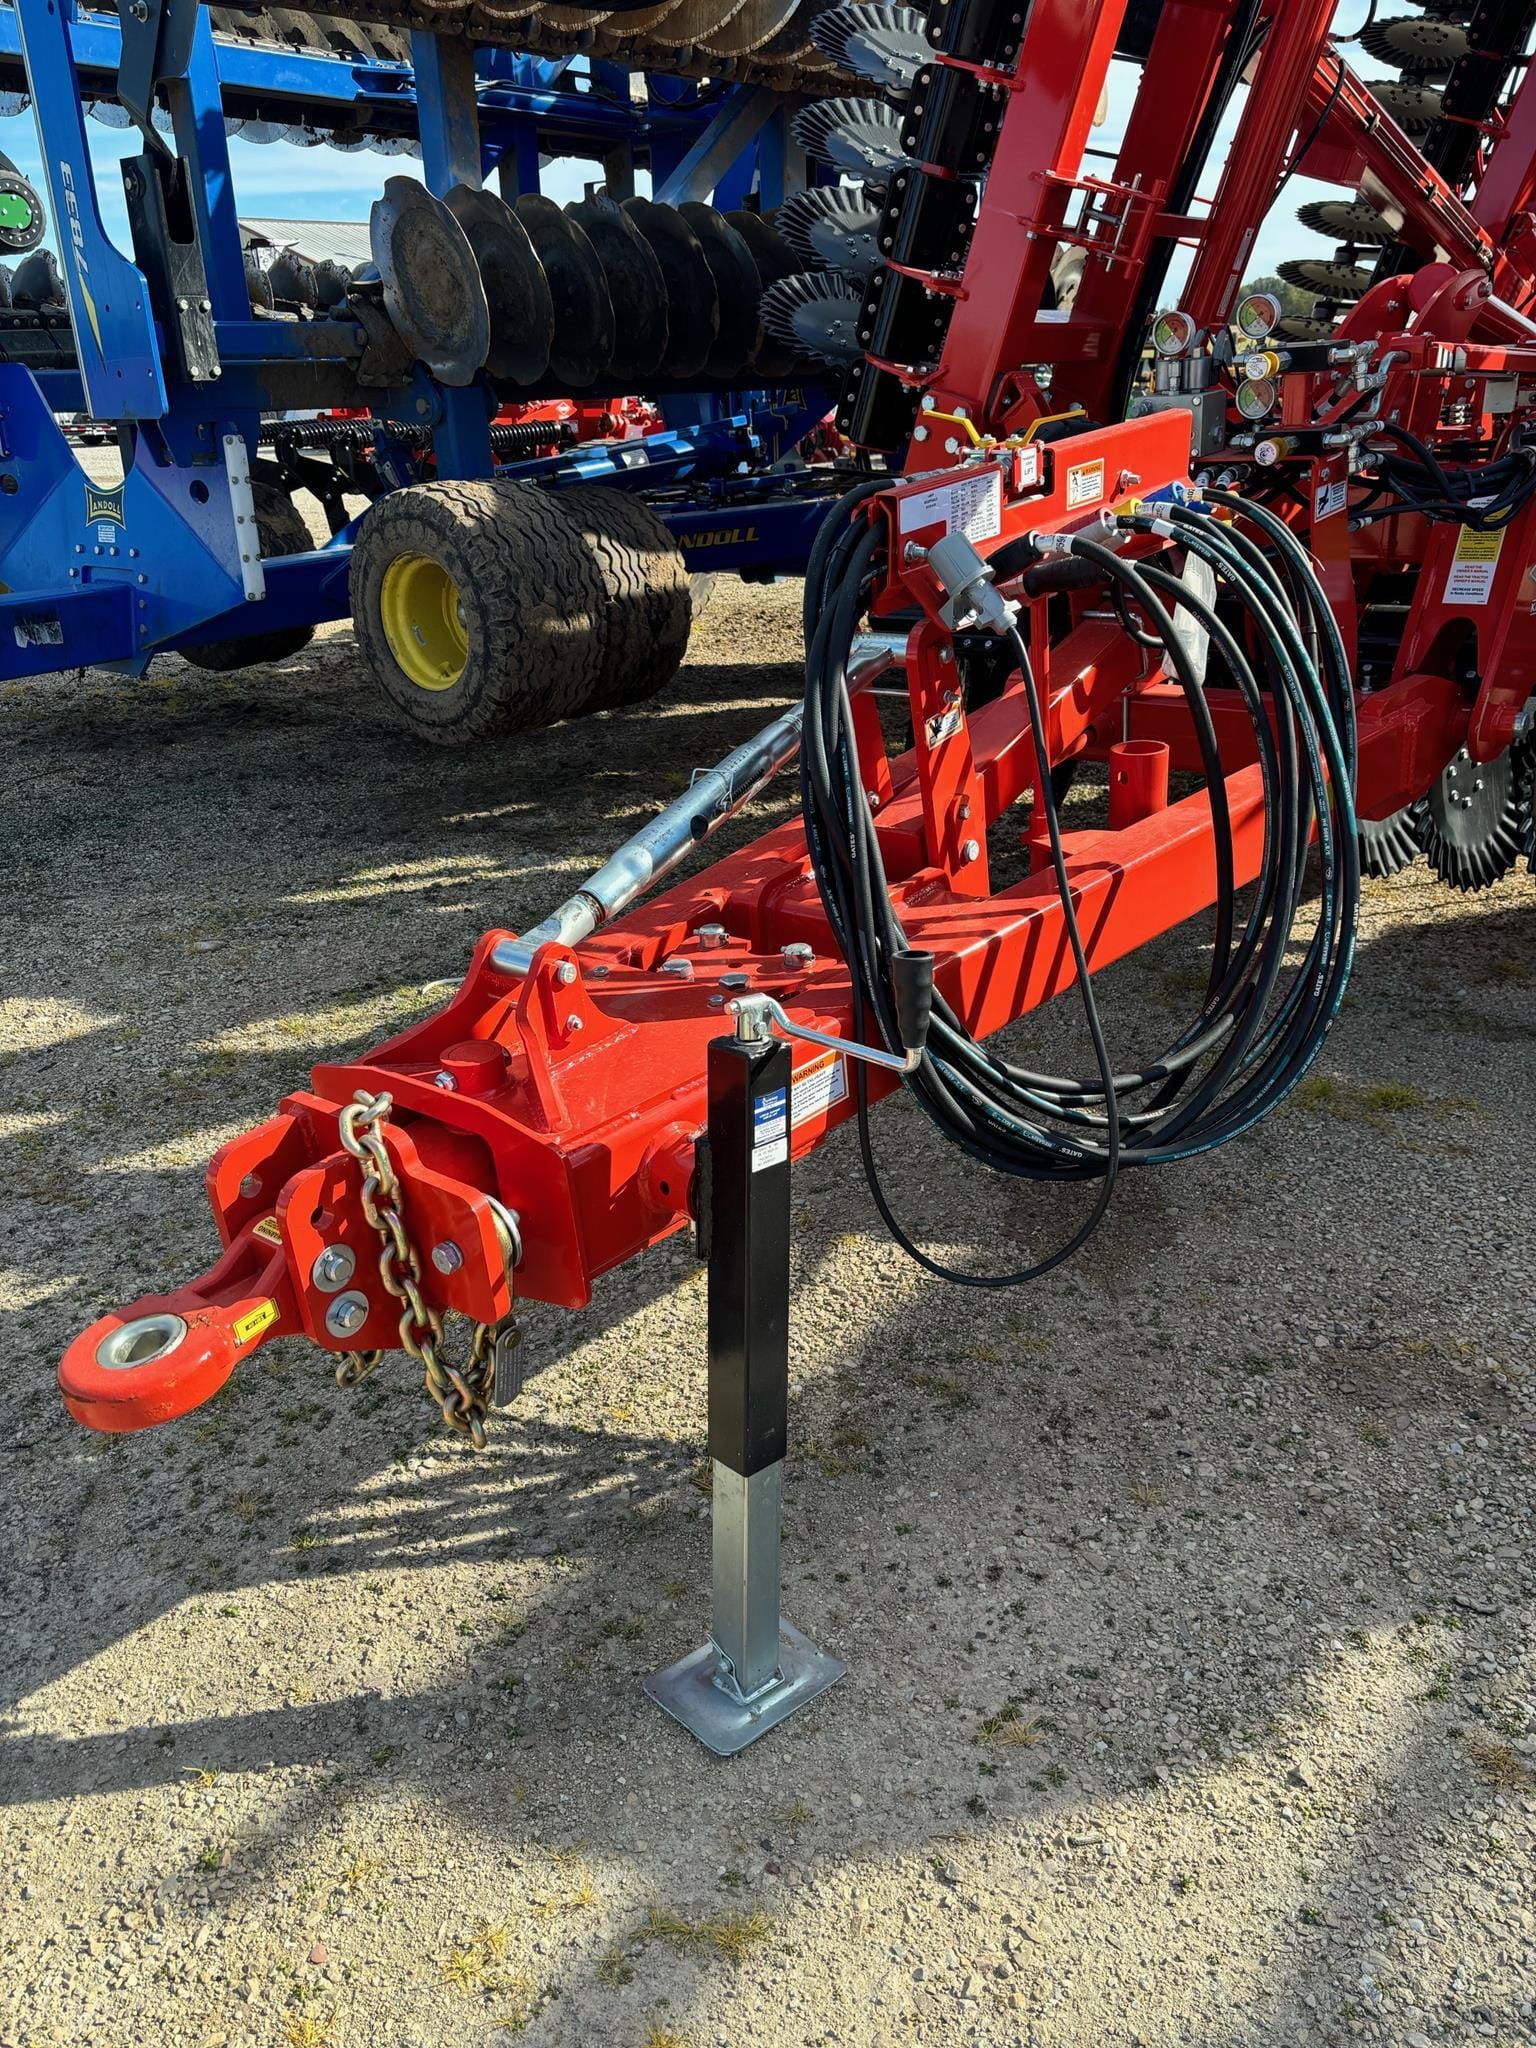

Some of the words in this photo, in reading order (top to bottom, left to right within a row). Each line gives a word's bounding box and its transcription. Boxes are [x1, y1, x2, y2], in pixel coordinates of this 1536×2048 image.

[89, 493, 122, 520] LANDOLL
[680, 527, 760, 549] NDOLL
[1217, 560, 1236, 582] GATES
[849, 832, 857, 860] GATES
[1352, 902, 1360, 926] GATES
[1313, 973, 1325, 997] GATES
[1205, 995, 1220, 1016] GATES
[791, 1060, 825, 1083] WARNING
[1060, 1147, 1083, 1158] GATES
